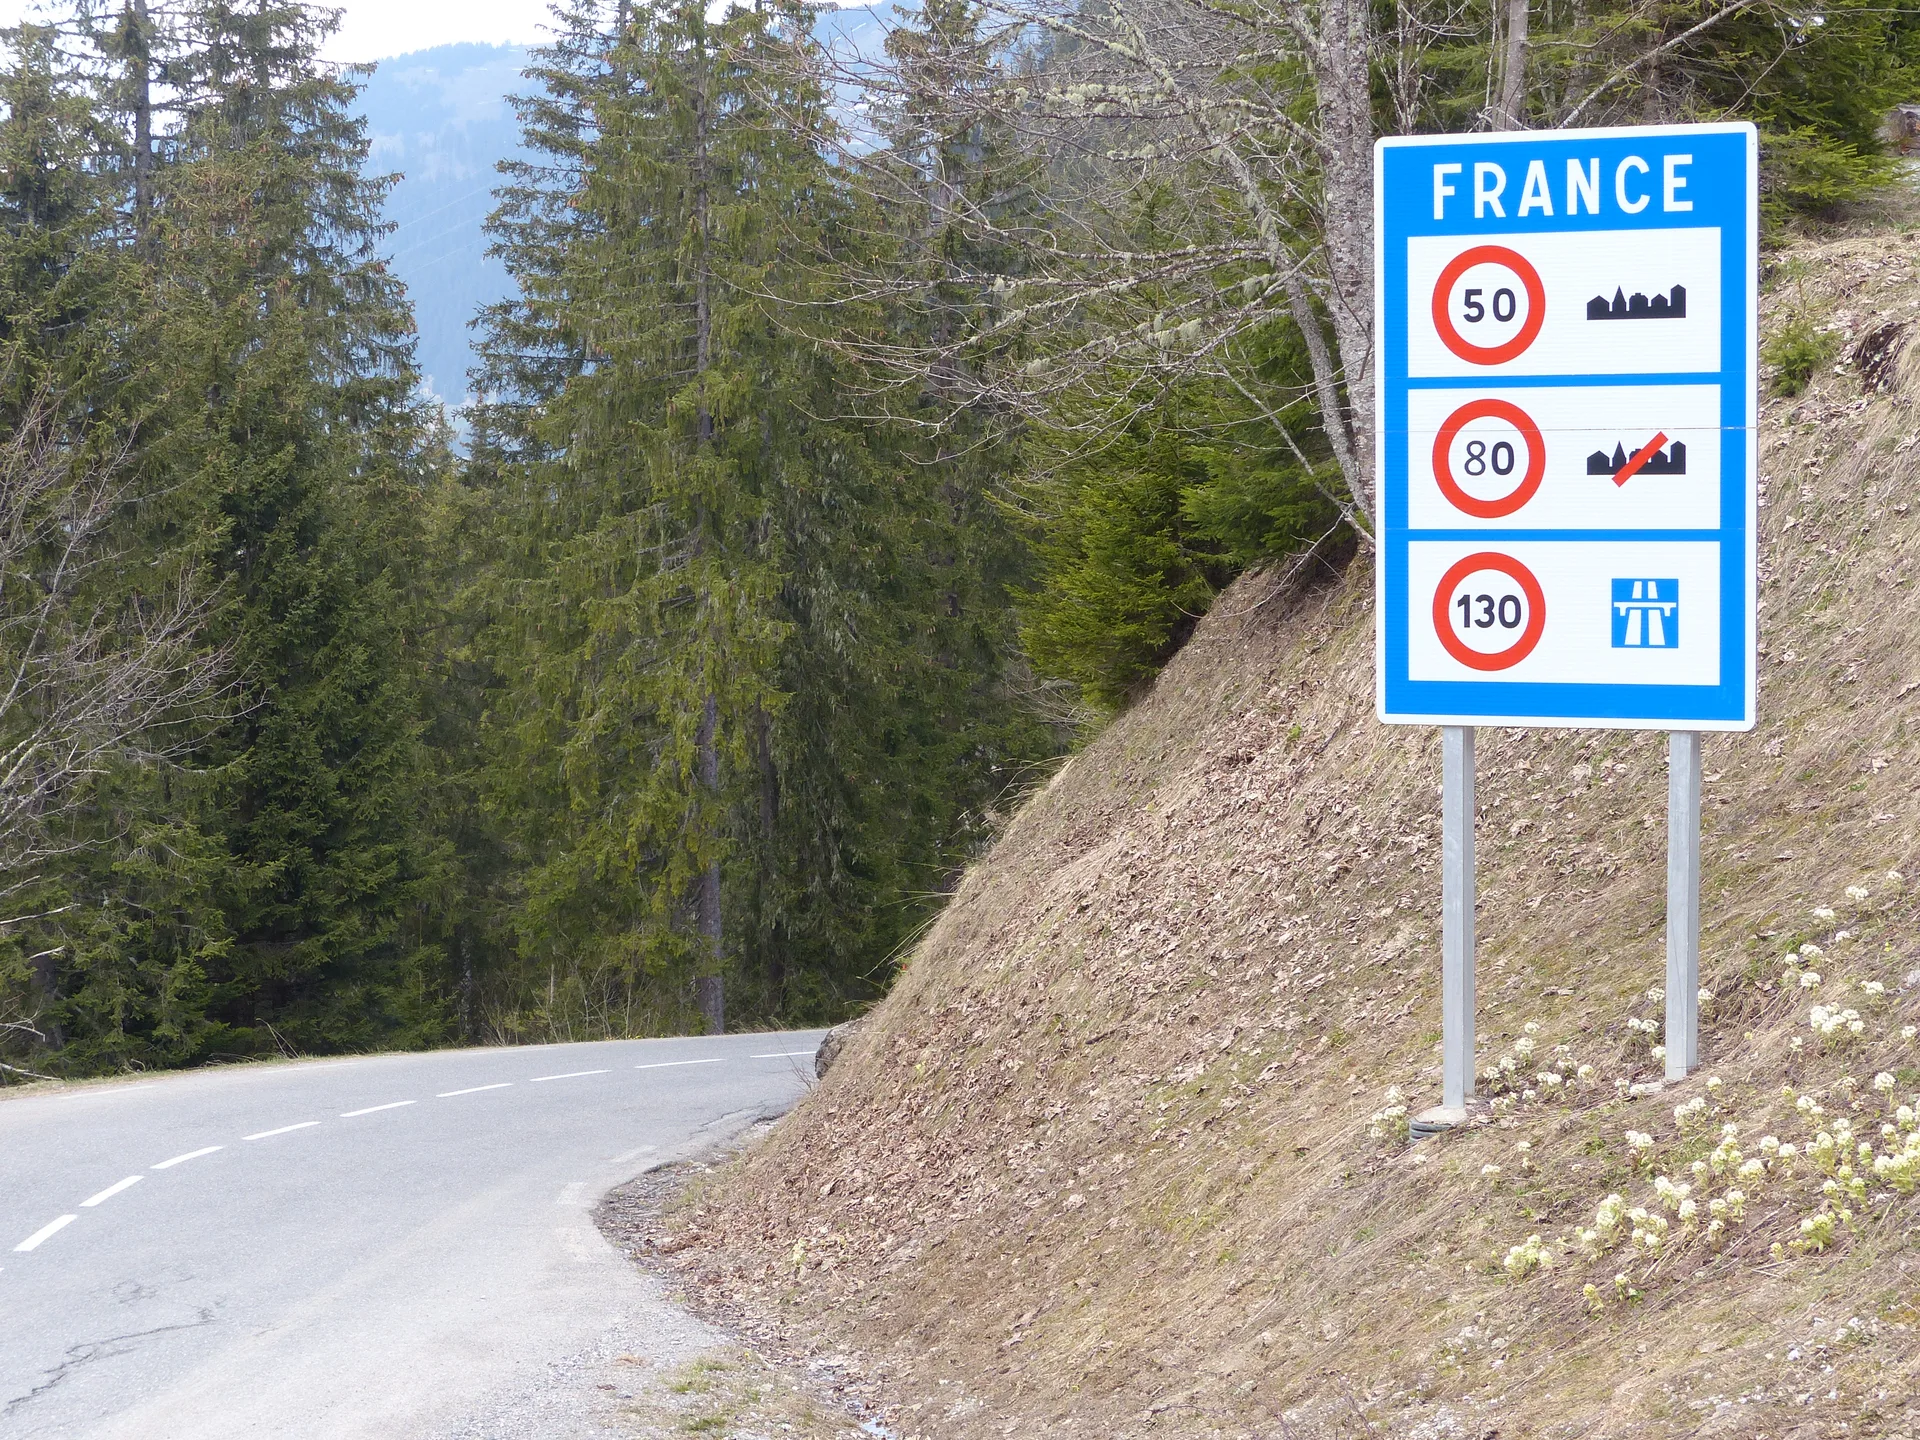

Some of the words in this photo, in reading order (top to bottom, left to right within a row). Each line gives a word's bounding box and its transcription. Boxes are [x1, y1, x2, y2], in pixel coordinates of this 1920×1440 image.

[1433, 153, 1694, 220] FRANCE
[1463, 288, 1516, 323] 50
[1464, 440, 1515, 476] 80
[1457, 594, 1522, 629] 130
